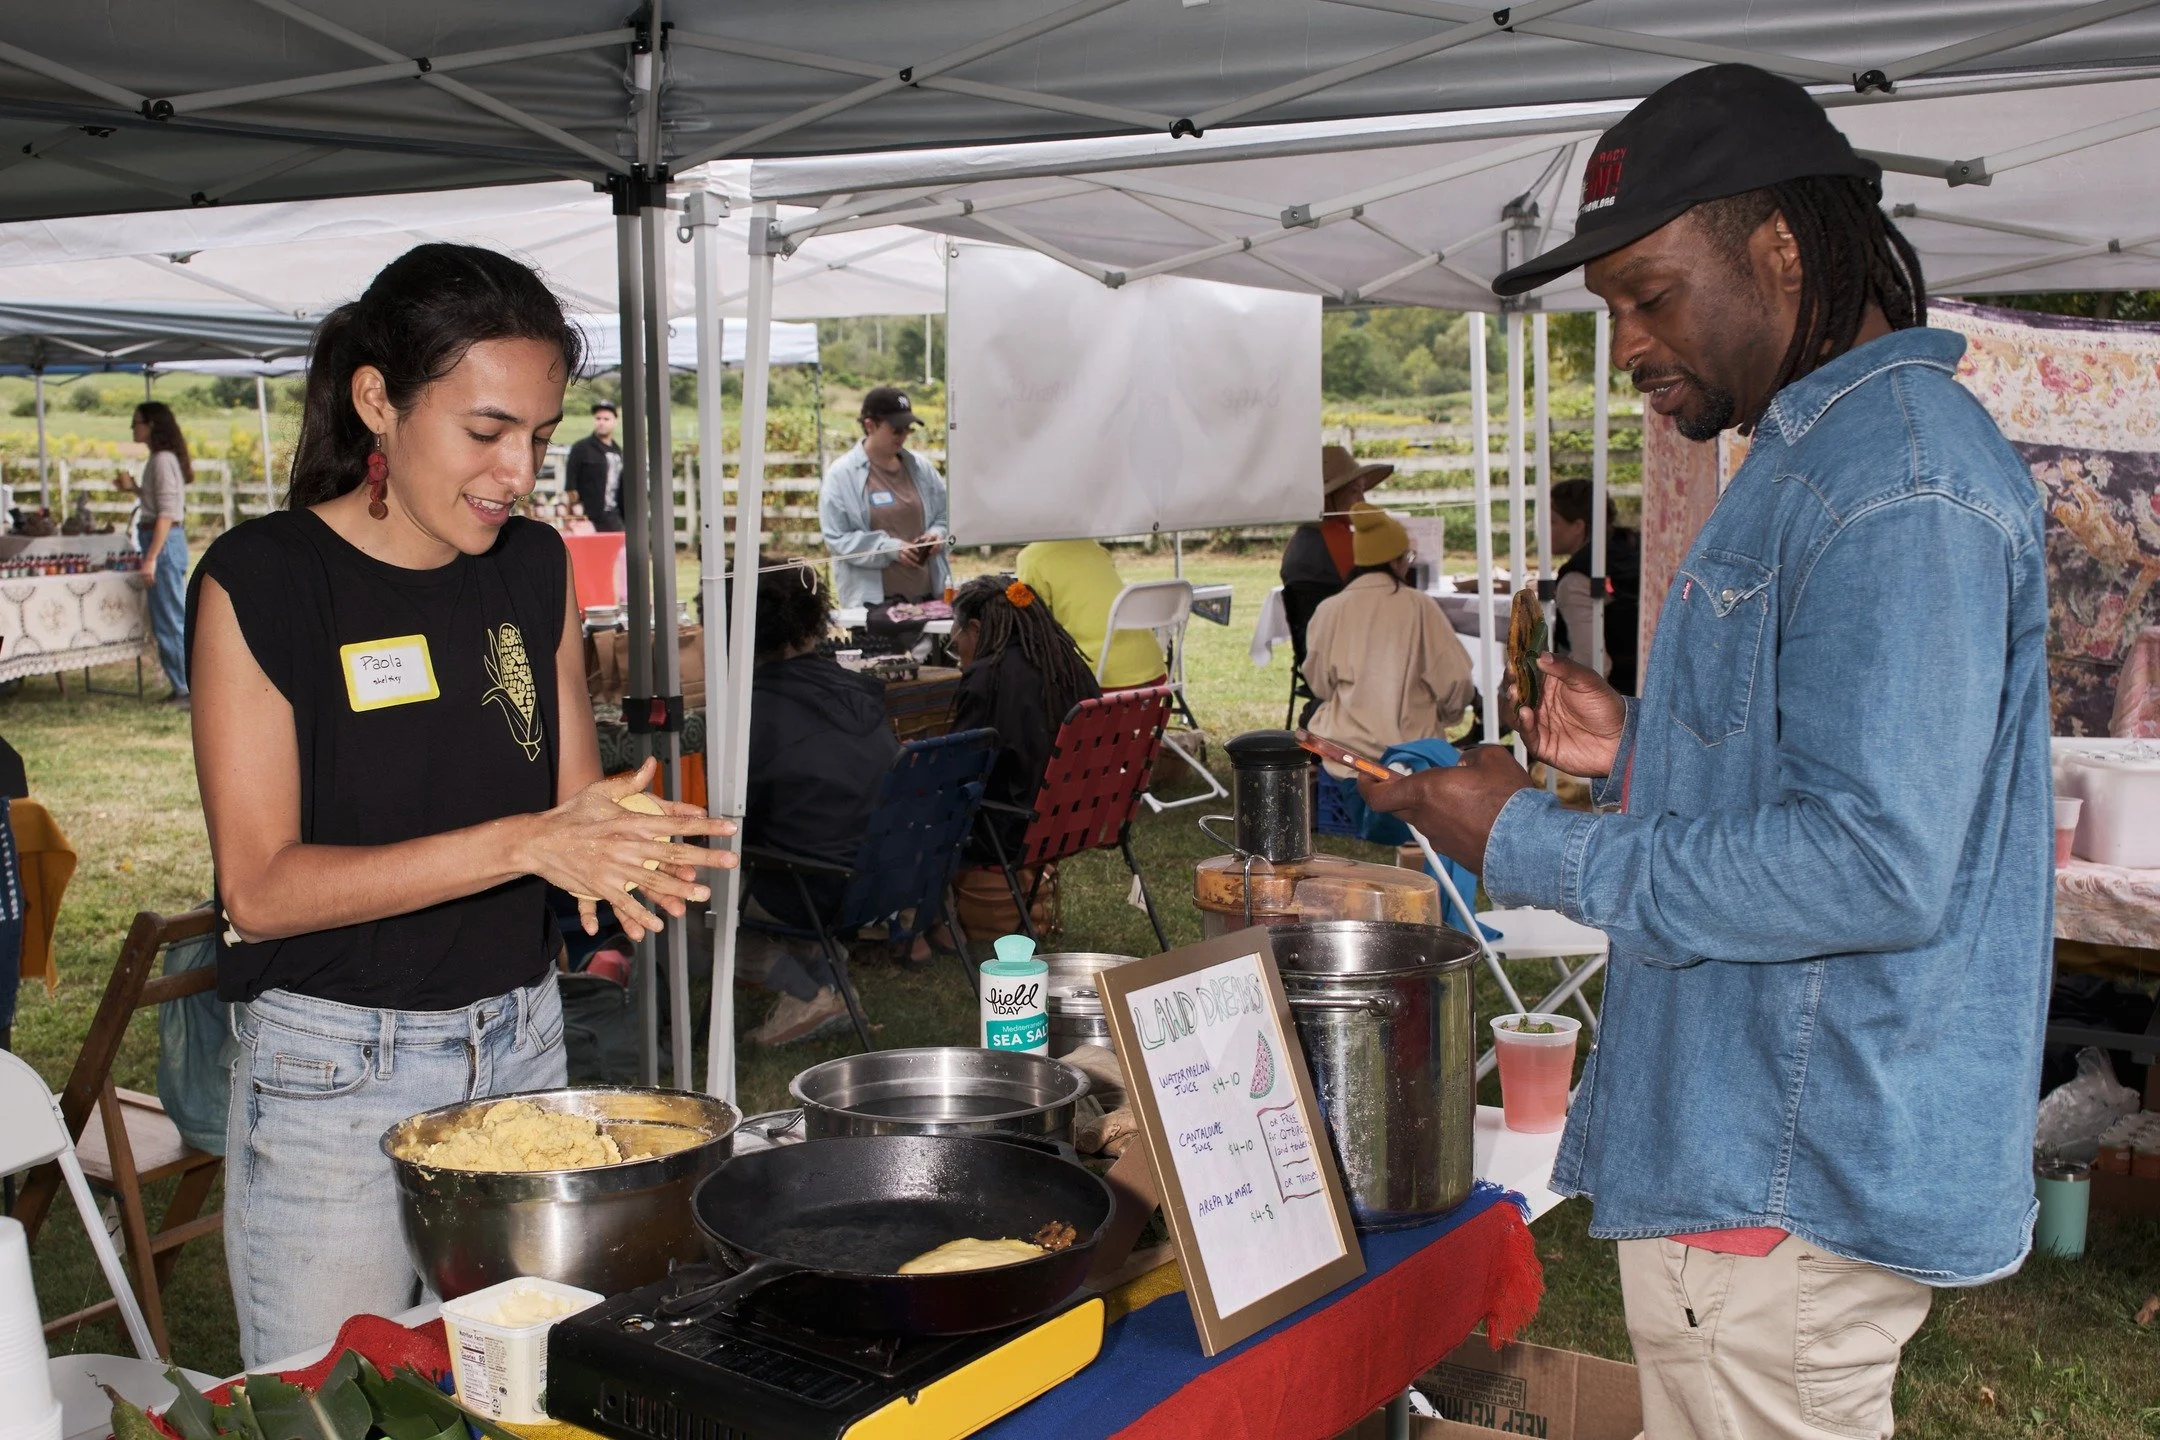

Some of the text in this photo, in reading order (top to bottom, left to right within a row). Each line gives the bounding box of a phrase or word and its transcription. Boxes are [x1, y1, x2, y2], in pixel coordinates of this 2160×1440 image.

[360, 654, 402, 670] Paola
[985, 983, 1039, 1014] field
[1133, 974, 1263, 1050] LAND DREAMS
[993, 1023, 1048, 1047] SEA SALT
[1158, 1061, 1210, 1088] WATERMELON
[1213, 1072, 1240, 1094] $4-10
[1174, 1081, 1199, 1096] JUICE
[1191, 1141, 1213, 1154] JUICE
[1228, 1139, 1254, 1156] $4-10
[1198, 1195, 1224, 1217] AREPA
